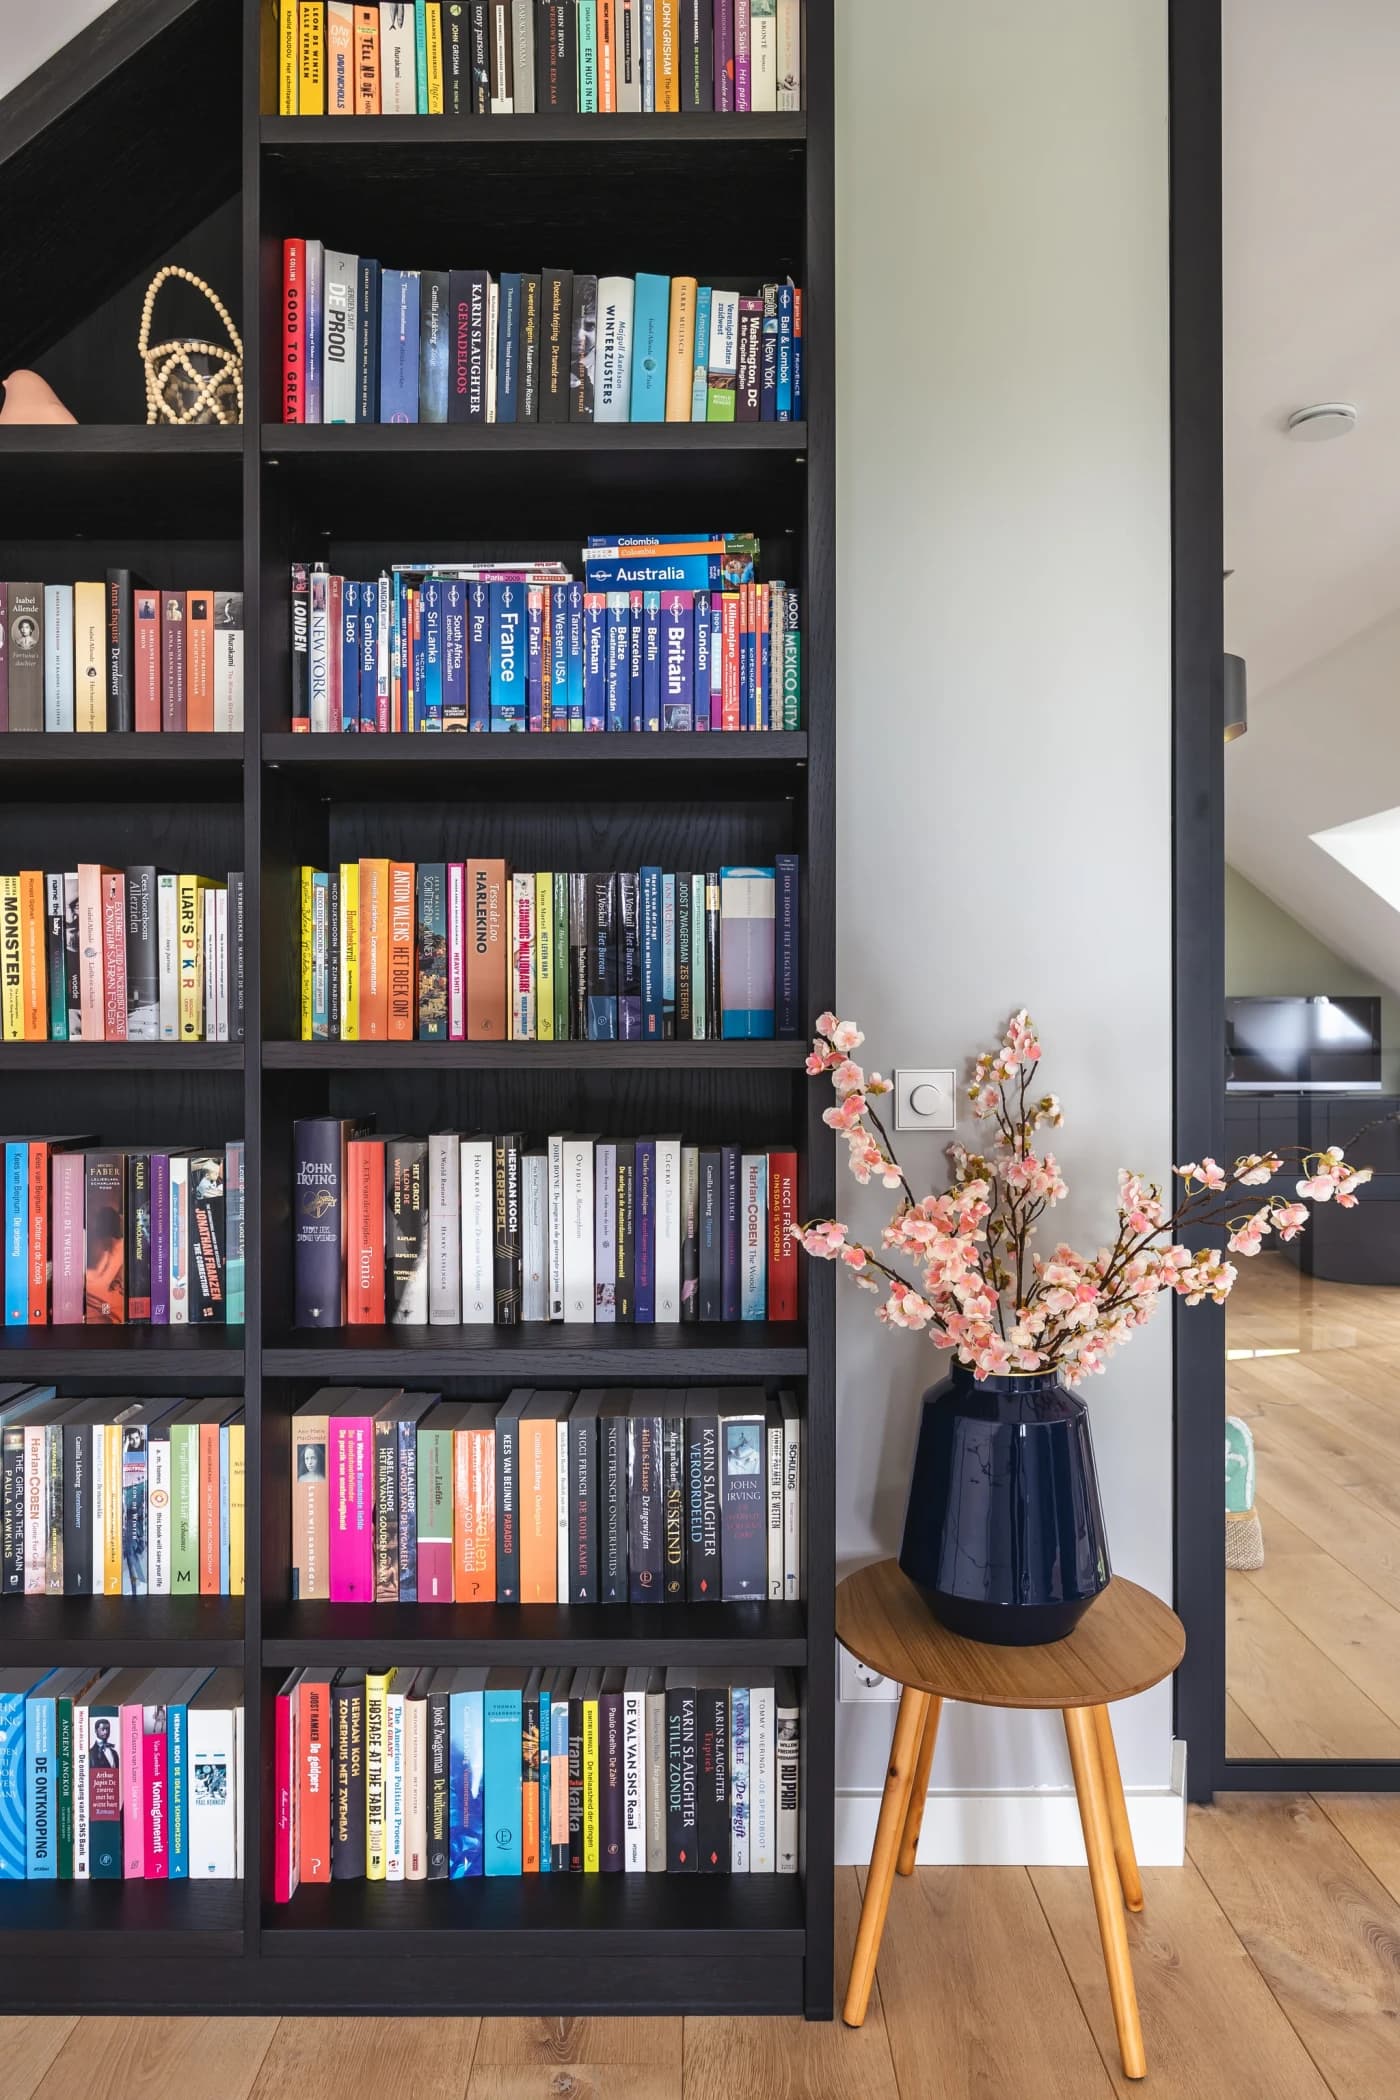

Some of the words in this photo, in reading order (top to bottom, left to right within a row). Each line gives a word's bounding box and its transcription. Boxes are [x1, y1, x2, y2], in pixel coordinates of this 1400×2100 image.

[663, 1, 671, 28] JOHN
[738, 2, 746, 28] Patrick
[313, 35, 318, 45] DE
[362, 38, 373, 60] TELL
[663, 29, 672, 74] GRISHAM
[739, 31, 747, 63] Süskind
[362, 83, 373, 98] ONE
[288, 289, 297, 333] GOOD
[329, 283, 345, 306] DE
[472, 284, 482, 327] KARIN
[328, 309, 345, 363] PROOI
[617, 321, 626, 351] Majgull
[726, 304, 734, 340] Verenigde
[781, 316, 789, 333] Bali
[288, 342, 297, 363] TO
[457, 302, 468, 394] GENADELOOS
[603, 305, 615, 404] WINTERZUSTERS
[748, 317, 759, 386] Washington,
[765, 339, 775, 362] New
[780, 346, 788, 383] Lombok
[470, 331, 481, 413] SLAUGHTER
[617, 354, 625, 388] Axelsson
[765, 366, 775, 389] York
[748, 390, 756, 407] DC
[618, 538, 659, 546] Colombia
[616, 568, 684, 581] Australia
[111, 583, 120, 606] Anna
[789, 594, 797, 629] MOON
[109, 609, 120, 644] Enquist
[294, 600, 306, 652] LONDEN
[313, 616, 325, 653] NEW
[346, 615, 357, 643] Laos
[428, 612, 437, 626] Sri
[454, 616, 462, 641] South
[474, 616, 484, 641] Peru
[556, 613, 565, 657] Western
[572, 613, 580, 655] Tanzania
[728, 603, 736, 658] Kilimanjaro
[112, 648, 120, 659] De
[364, 615, 374, 670] Cambodia
[428, 630, 437, 663] Lanka
[454, 643, 463, 668] Africa
[501, 613, 518, 681] France
[530, 627, 540, 655] Paris
[591, 627, 601, 674] Vietnam
[618, 627, 626, 660] Belize
[632, 627, 640, 677] Barcelona
[648, 627, 657, 660] Berlin
[699, 624, 709, 670] London
[112, 661, 121, 695] verdovers
[313, 656, 325, 699] YORK
[556, 661, 565, 684] USA
[669, 628, 685, 694] Britain
[785, 635, 797, 690] MEXICO
[785, 695, 797, 726] CITY
[394, 871, 410, 902] ANTON
[489, 884, 499, 908] Tessa
[679, 882, 689, 908] JOOST
[130, 881, 141, 933] Allerzielen
[182, 888, 193, 934] LIAR'S
[394, 906, 410, 941] VALENS
[476, 872, 487, 953] HARLEKINO
[490, 911, 499, 921] de
[5, 898, 19, 986] MONSTER
[490, 924, 499, 941] Loo
[680, 911, 689, 962] ZWAGERMAN
[393, 947, 409, 966] HET
[680, 965, 689, 980] ZES
[393, 970, 408, 996] BOEK
[393, 1000, 408, 1019] ONT
[681, 983, 689, 1019] STERREN
[302, 1162, 332, 1173] JOHN
[496, 1149, 505, 1167] DE
[508, 1149, 516, 1198] HERMAN
[297, 1173, 337, 1185] IRVING
[749, 1166, 758, 1203] Harlan
[497, 1170, 505, 1232] GREPPEL
[509, 1200, 517, 1232] KOCH
[774, 1214, 780, 1222] IS
[748, 1205, 758, 1246] COBEN
[783, 1212, 791, 1256] FRENCH
[195, 1208, 211, 1255] JONATHAN
[205, 1257, 221, 1300] FRANZEN
[361, 1247, 374, 1288] Tonio
[749, 1266, 757, 1292] Woods
[503, 1434, 511, 1455] KEES
[608, 1427, 616, 1456] NICCI
[704, 1429, 715, 1471] KARIN
[608, 1460, 616, 1503] FRENCH
[788, 1444, 797, 1489] SCHULDIG
[504, 1476, 512, 1511] BEIJNUM
[690, 1443, 702, 1542] VEROORDEELD
[16, 1503, 23, 1517] ON
[667, 1489, 682, 1564] SÜSKIND
[704, 1476, 715, 1556] SLAUGHTER
[4, 1511, 12, 1558] HAWKINS
[609, 1506, 617, 1576] ONDERHUIDS
[16, 1543, 24, 1571] TRAIN
[352, 1698, 360, 1743] HERMAN
[627, 1700, 636, 1715] DE
[682, 1700, 694, 1741] KARIN
[339, 1699, 348, 1760] ZOMERHUIS
[627, 1720, 636, 1741] VAL
[669, 1715, 680, 1758] STILLE
[36, 1758, 47, 1773] DE
[352, 1748, 361, 1776] KOCH
[569, 1736, 583, 1777] franz
[627, 1745, 636, 1769] VAN
[781, 1765, 796, 1781] AU
[340, 1764, 348, 1785] MET
[627, 1773, 637, 1796] SNS
[669, 1763, 681, 1812] ZONDE
[683, 1746, 694, 1827] SLAUGHTER
[569, 1786, 583, 1832] kafka
[781, 1783, 796, 1810] PAIR
[36, 1777, 48, 1858] ONTKNOPING
[151, 1781, 163, 1853] Koninginnenrit
[340, 1789, 348, 1841] ZWEMBAD
[627, 1800, 637, 1830] Reaal
